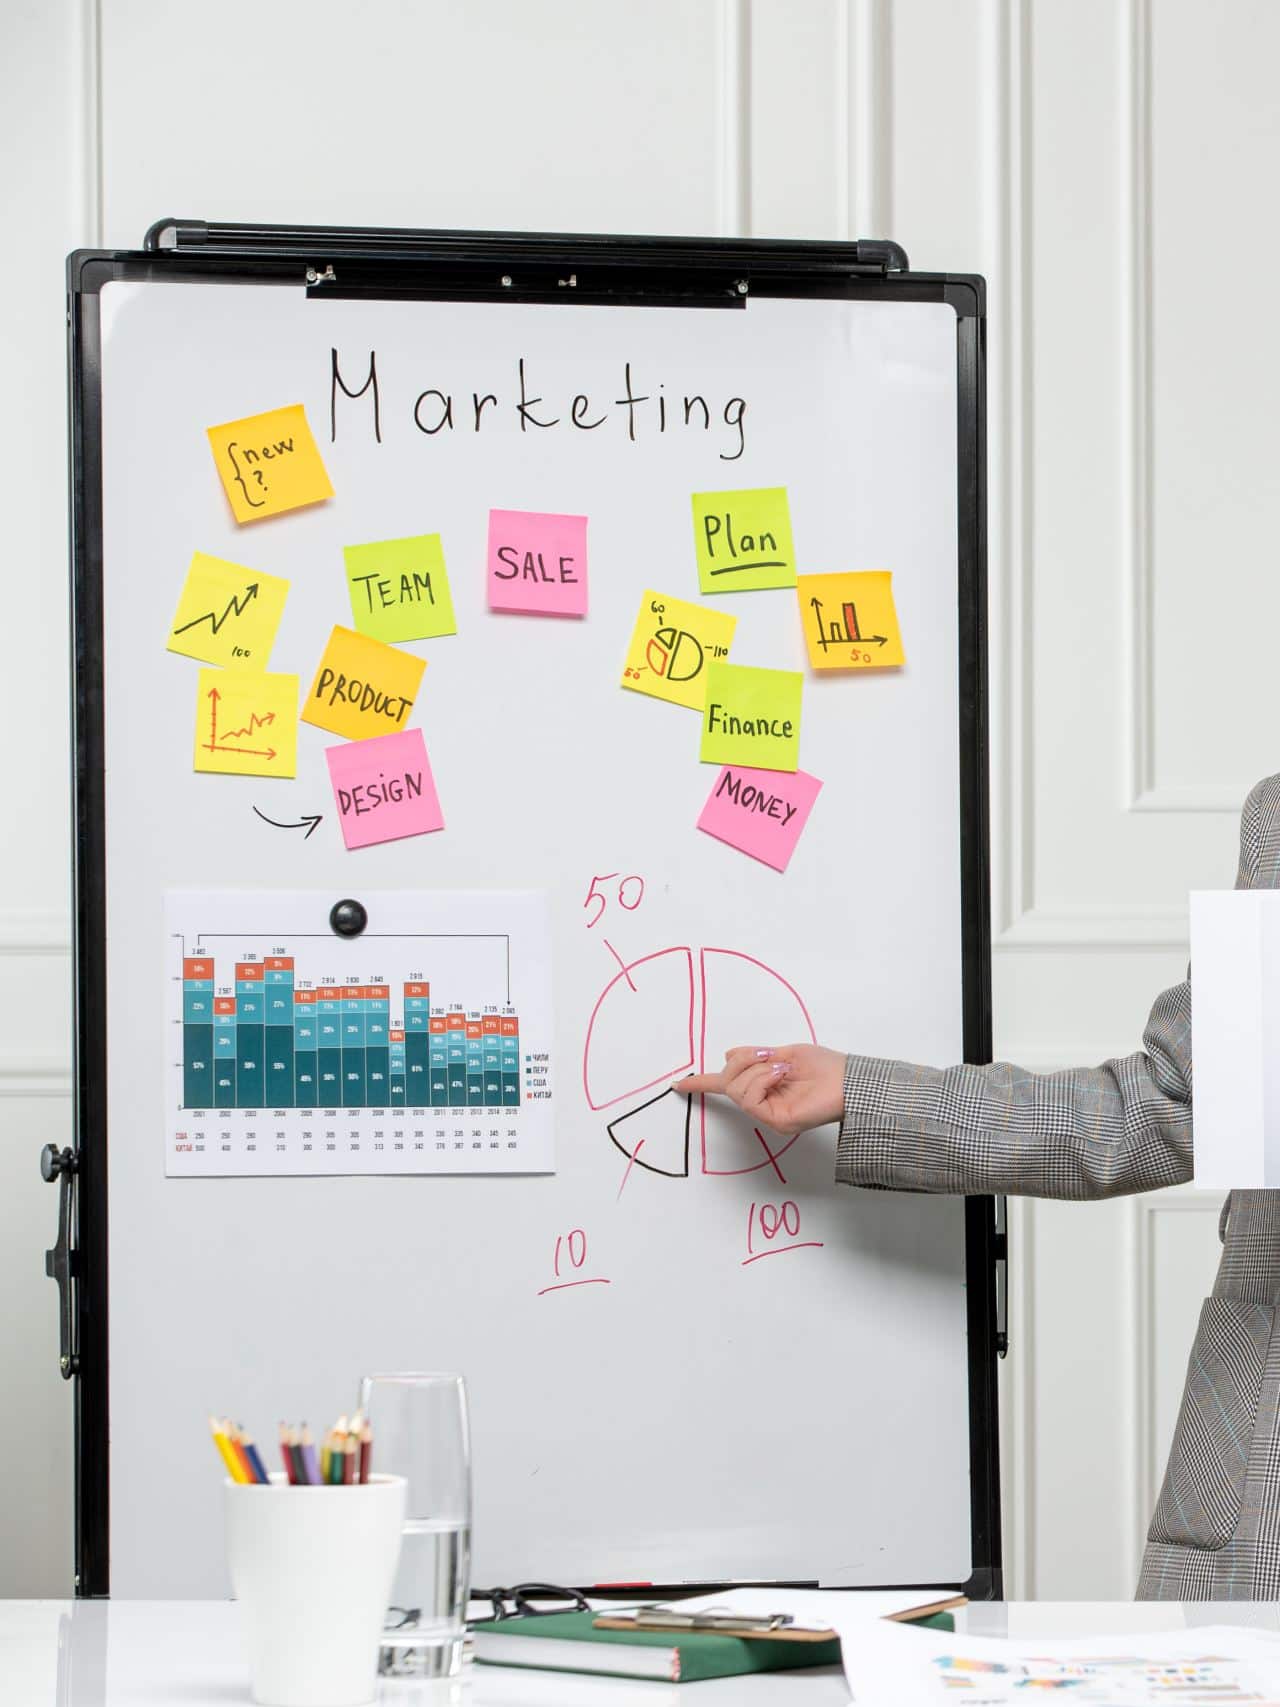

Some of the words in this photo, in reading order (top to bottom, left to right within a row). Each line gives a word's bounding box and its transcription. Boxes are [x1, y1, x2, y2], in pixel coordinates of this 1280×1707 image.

[331, 347, 747, 461] Marketing
[243, 437, 296, 464] new
[703, 513, 777, 558] Plan
[493, 546, 578, 584] SALE
[352, 572, 435, 614] TEAM
[651, 600, 665, 613] 60
[231, 645, 251, 658] 100
[849, 648, 872, 664] 50
[315, 668, 414, 723] PRODUCT
[708, 703, 793, 739] Finance
[715, 770, 798, 827] MONEY
[583, 872, 645, 929] 50
[747, 1200, 802, 1254] 100
[553, 1228, 587, 1278] 10
